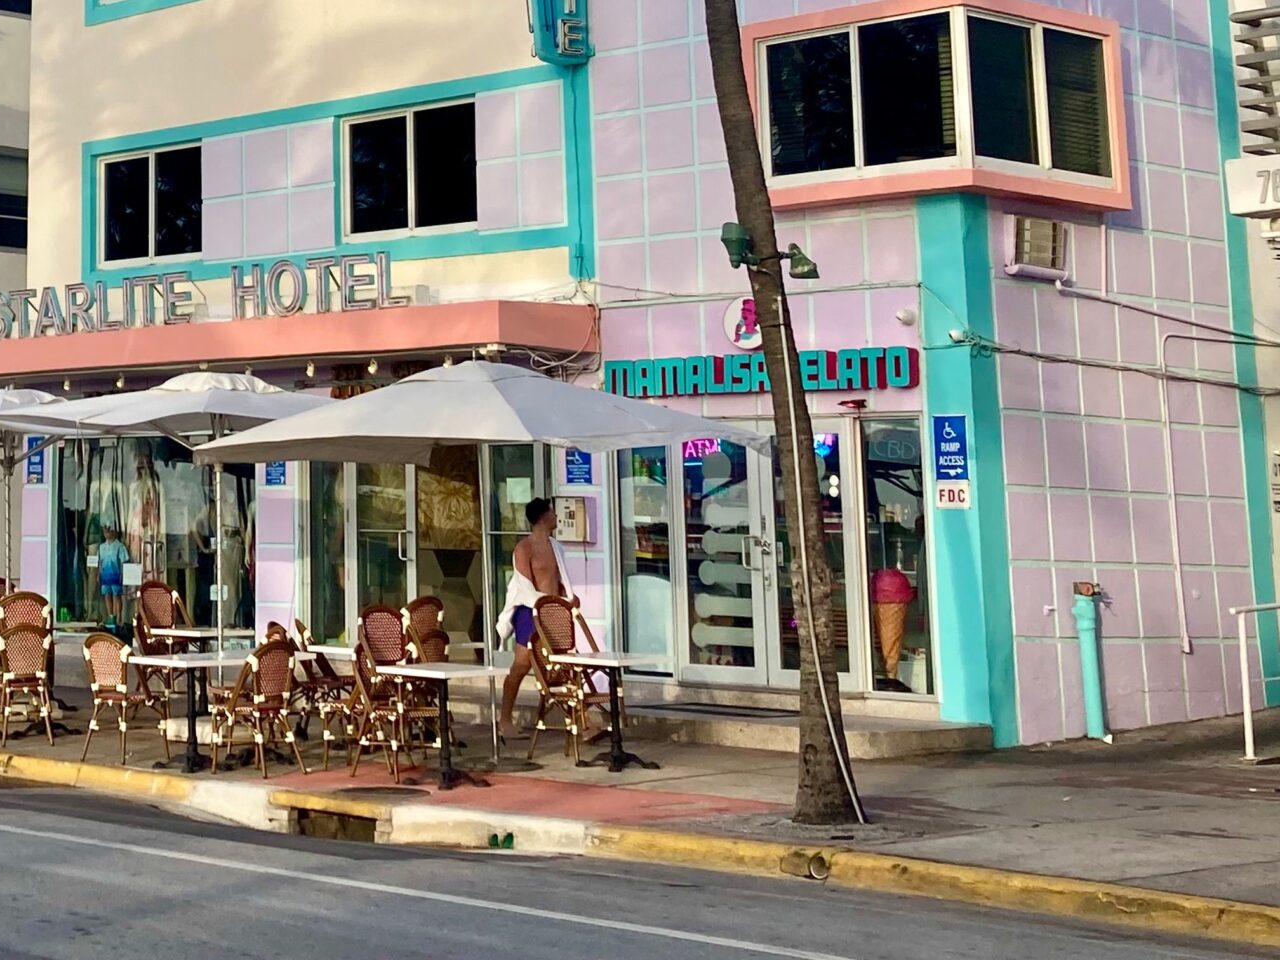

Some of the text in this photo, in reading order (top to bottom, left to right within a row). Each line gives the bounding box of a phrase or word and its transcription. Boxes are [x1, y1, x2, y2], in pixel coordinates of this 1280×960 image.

[231, 251, 411, 319] HOTEL
[798, 346, 920, 392] ELATO
[872, 439, 916, 459] CBD
[940, 442, 961, 452] RAMP
[938, 455, 965, 466] ACCESS
